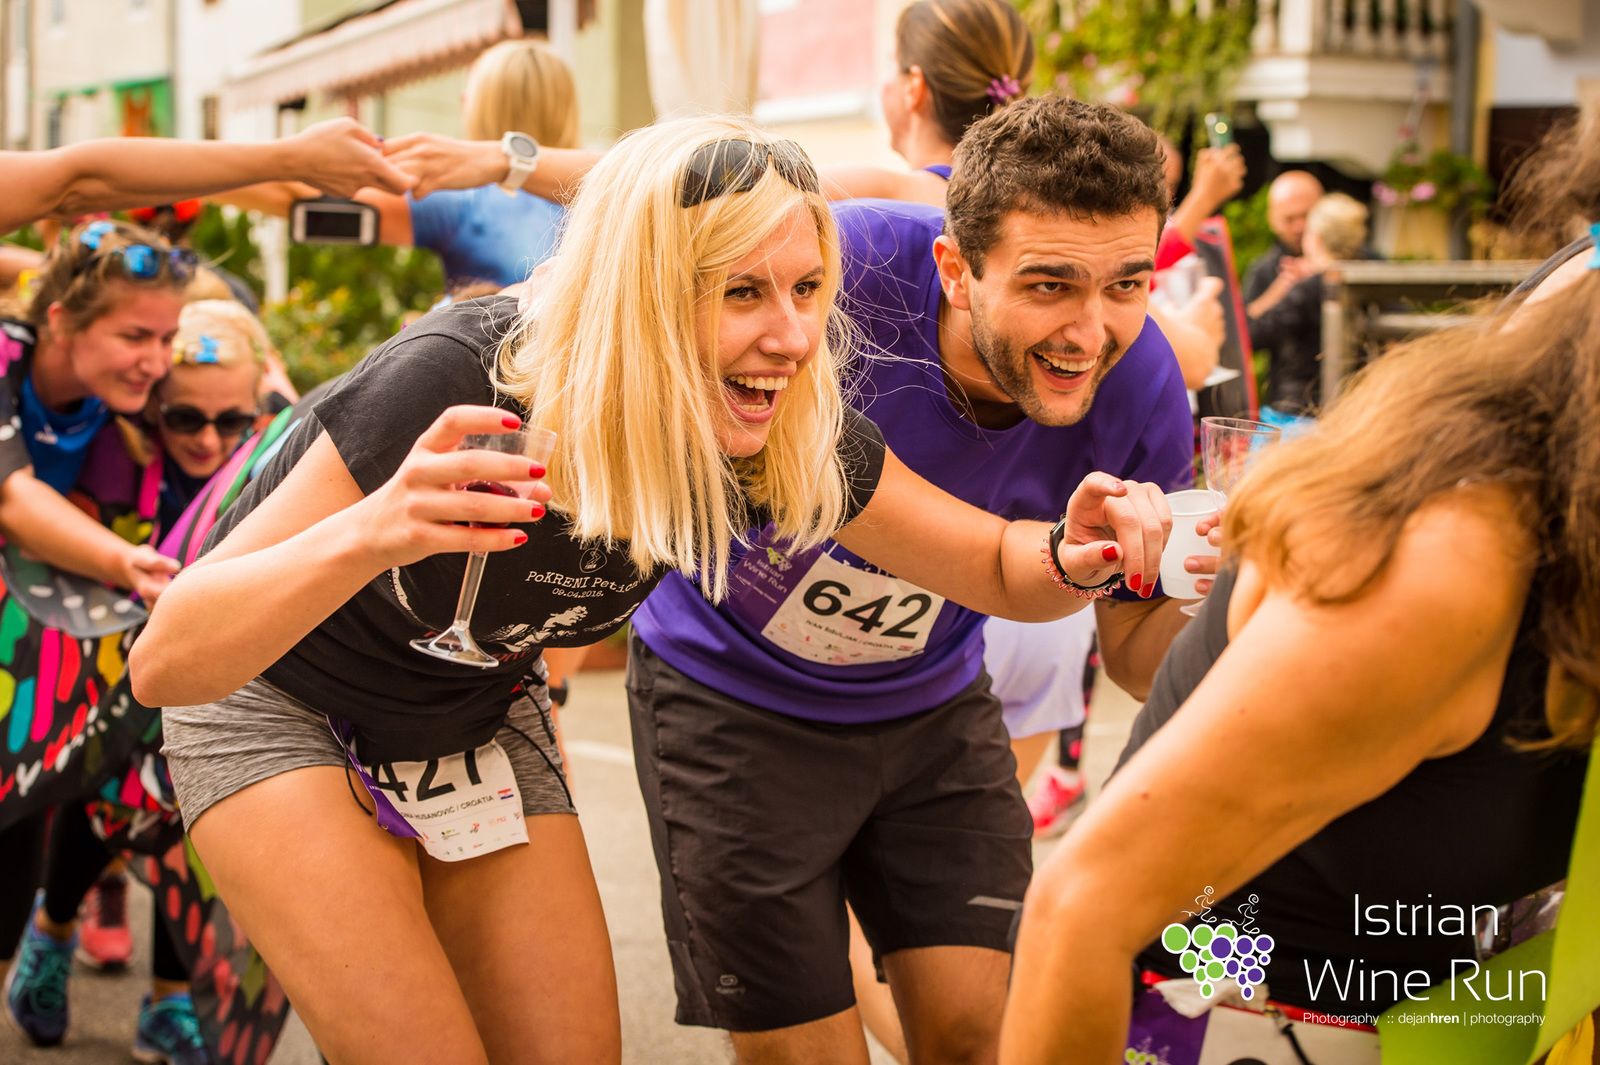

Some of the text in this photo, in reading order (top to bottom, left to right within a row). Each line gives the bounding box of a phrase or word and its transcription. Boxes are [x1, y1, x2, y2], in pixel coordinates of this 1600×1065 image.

[525, 570, 591, 588] PoKRENI
[743, 560, 768, 580] Wine
[768, 576, 788, 593] Run
[802, 579, 932, 639] 642
[460, 794, 495, 810] CROATIA
